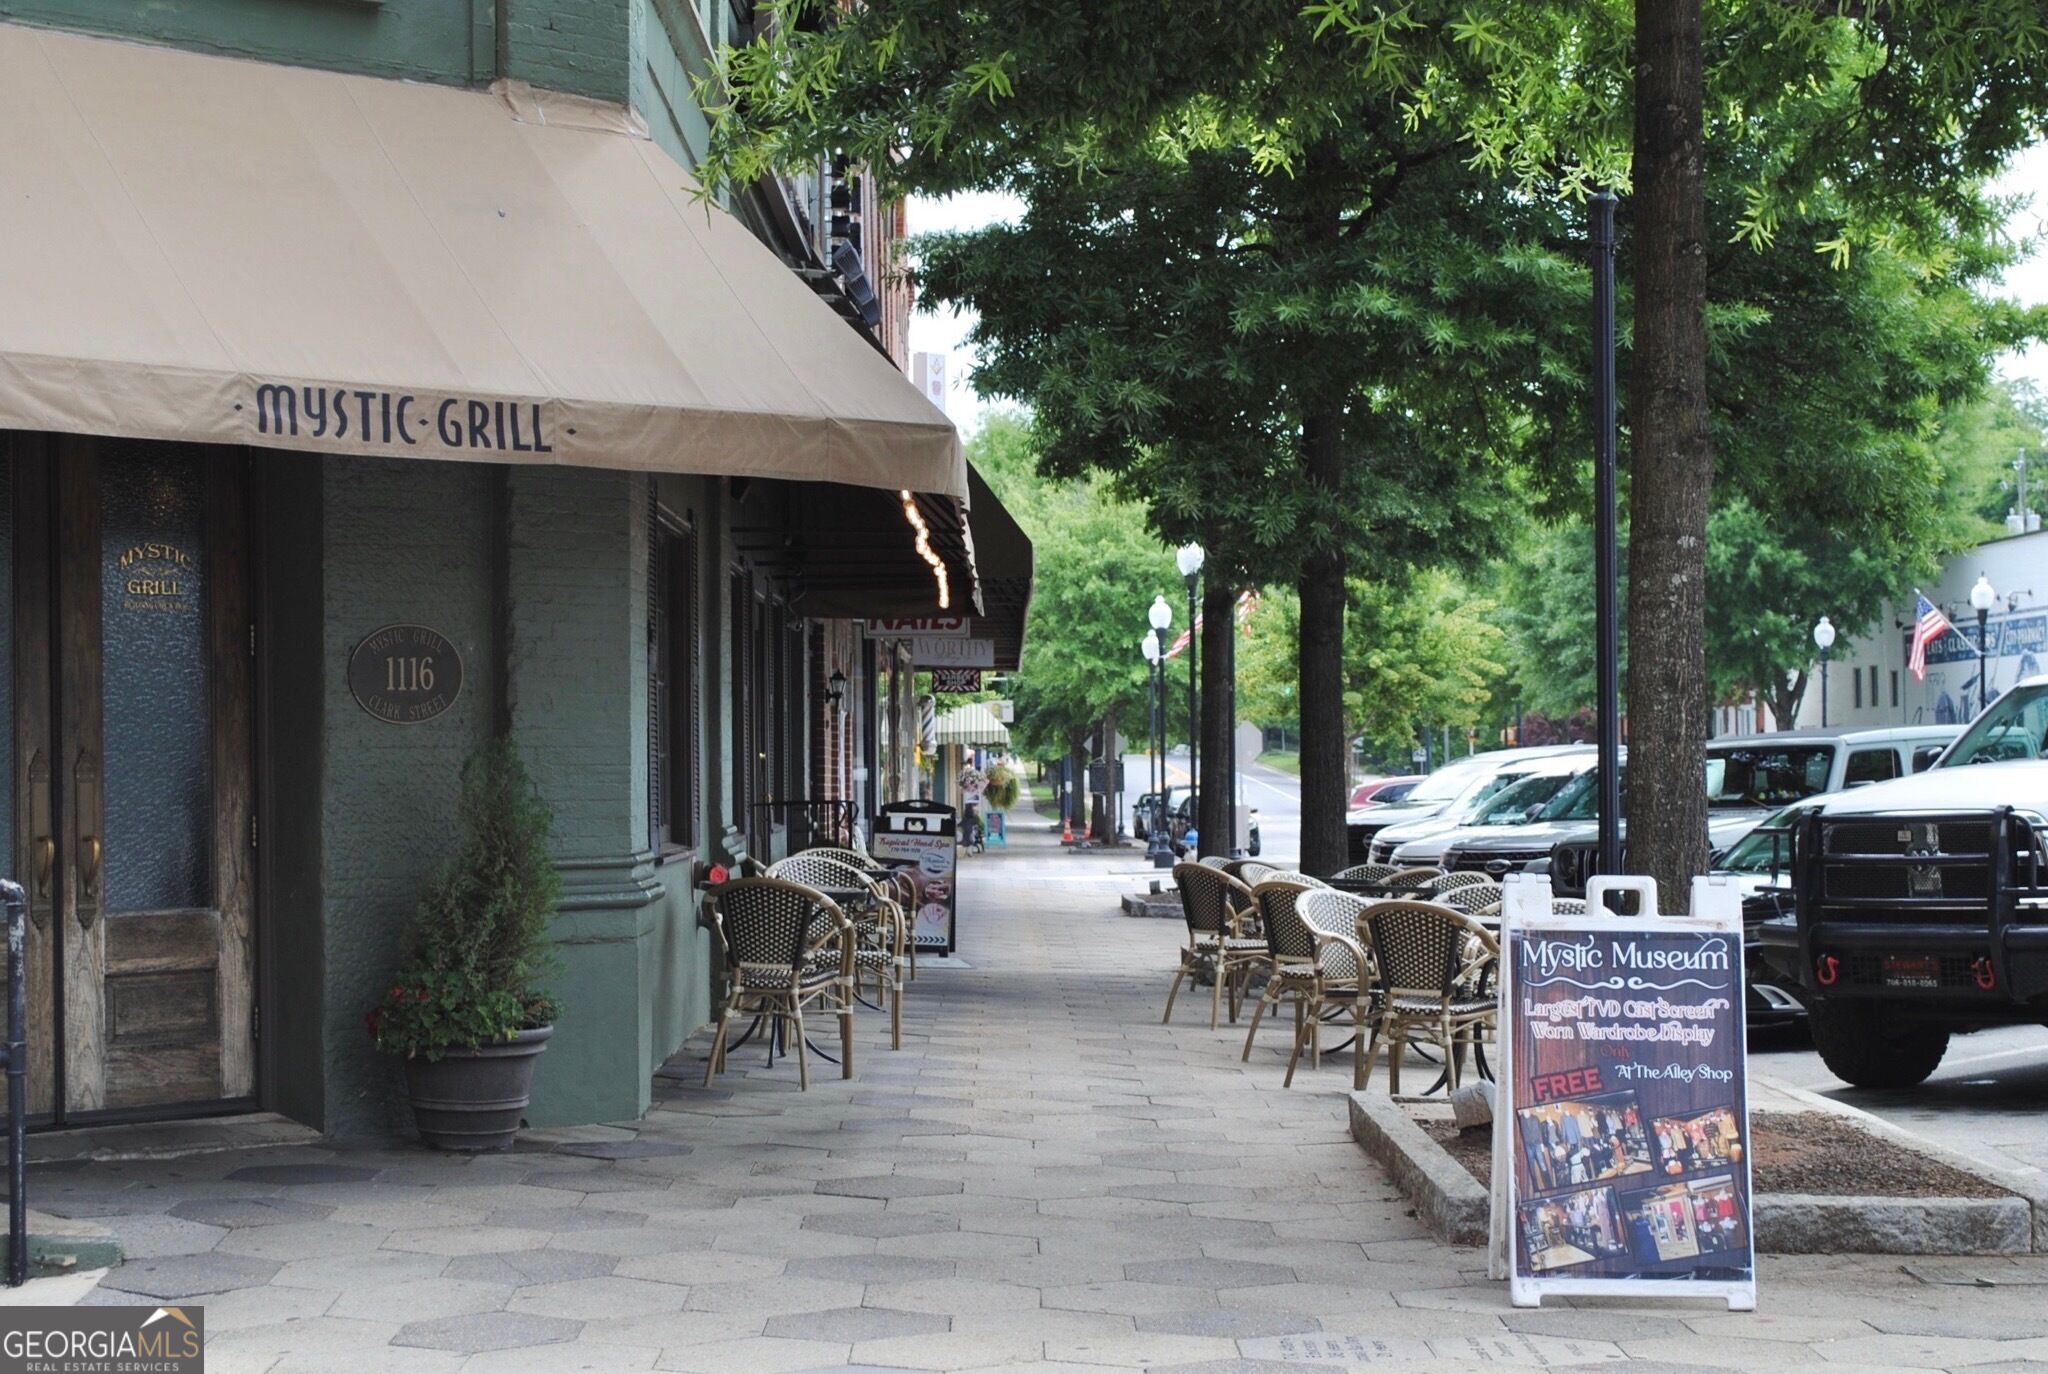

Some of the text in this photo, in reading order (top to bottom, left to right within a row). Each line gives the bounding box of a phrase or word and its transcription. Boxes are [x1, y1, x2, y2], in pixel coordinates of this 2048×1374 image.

[256, 383, 553, 453] MYSTIC GRILL
[120, 542, 194, 572] MYSTIC
[128, 579, 188, 596] GRILL
[369, 629, 444, 655] MYSTIC GRILL
[385, 656, 434, 691] 1116
[368, 693, 447, 720] CLARK STREET
[1523, 935, 1728, 976] Mystic Museum
[1525, 996, 1730, 1022] Largest TVD Cast Screen
[1530, 1021, 1715, 1047] Worn Wardrobe Display
[1532, 1067, 1602, 1101] FREE
[1615, 1062, 1734, 1083] At The Alley Shop
